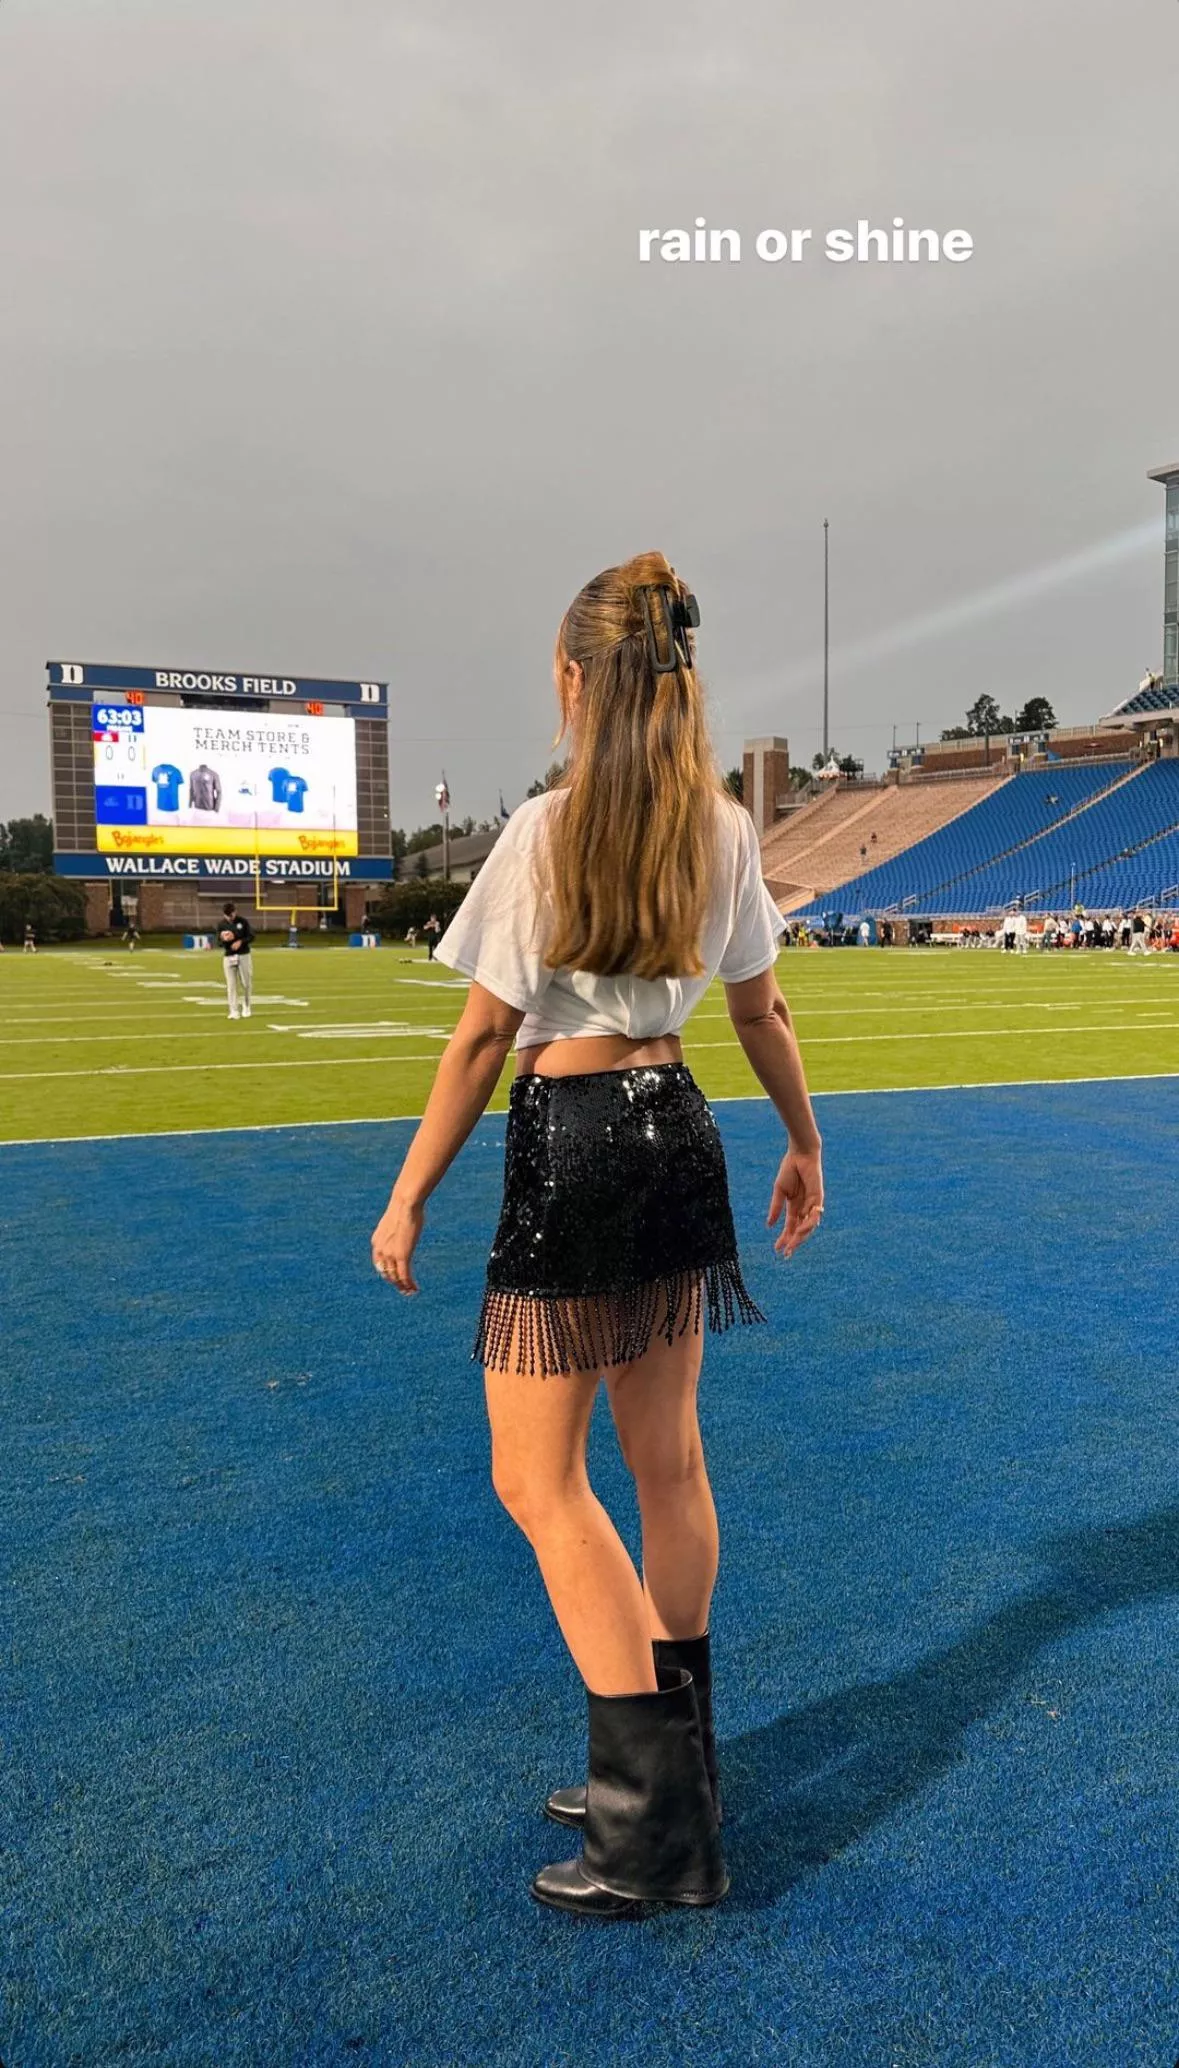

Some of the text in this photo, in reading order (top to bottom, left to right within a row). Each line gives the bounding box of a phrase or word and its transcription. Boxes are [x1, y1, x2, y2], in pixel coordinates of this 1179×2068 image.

[60, 664, 84, 684] D
[155, 671, 297, 696] BROOKS FIELD
[360, 683, 380, 702] D
[97, 708, 142, 726] 63:03
[193, 727, 241, 740] TEAM
[246, 730, 296, 743] STORE
[195, 739, 310, 755] MERCH TENTS
[105, 857, 351, 876] WALLACE WADE STADIUM
